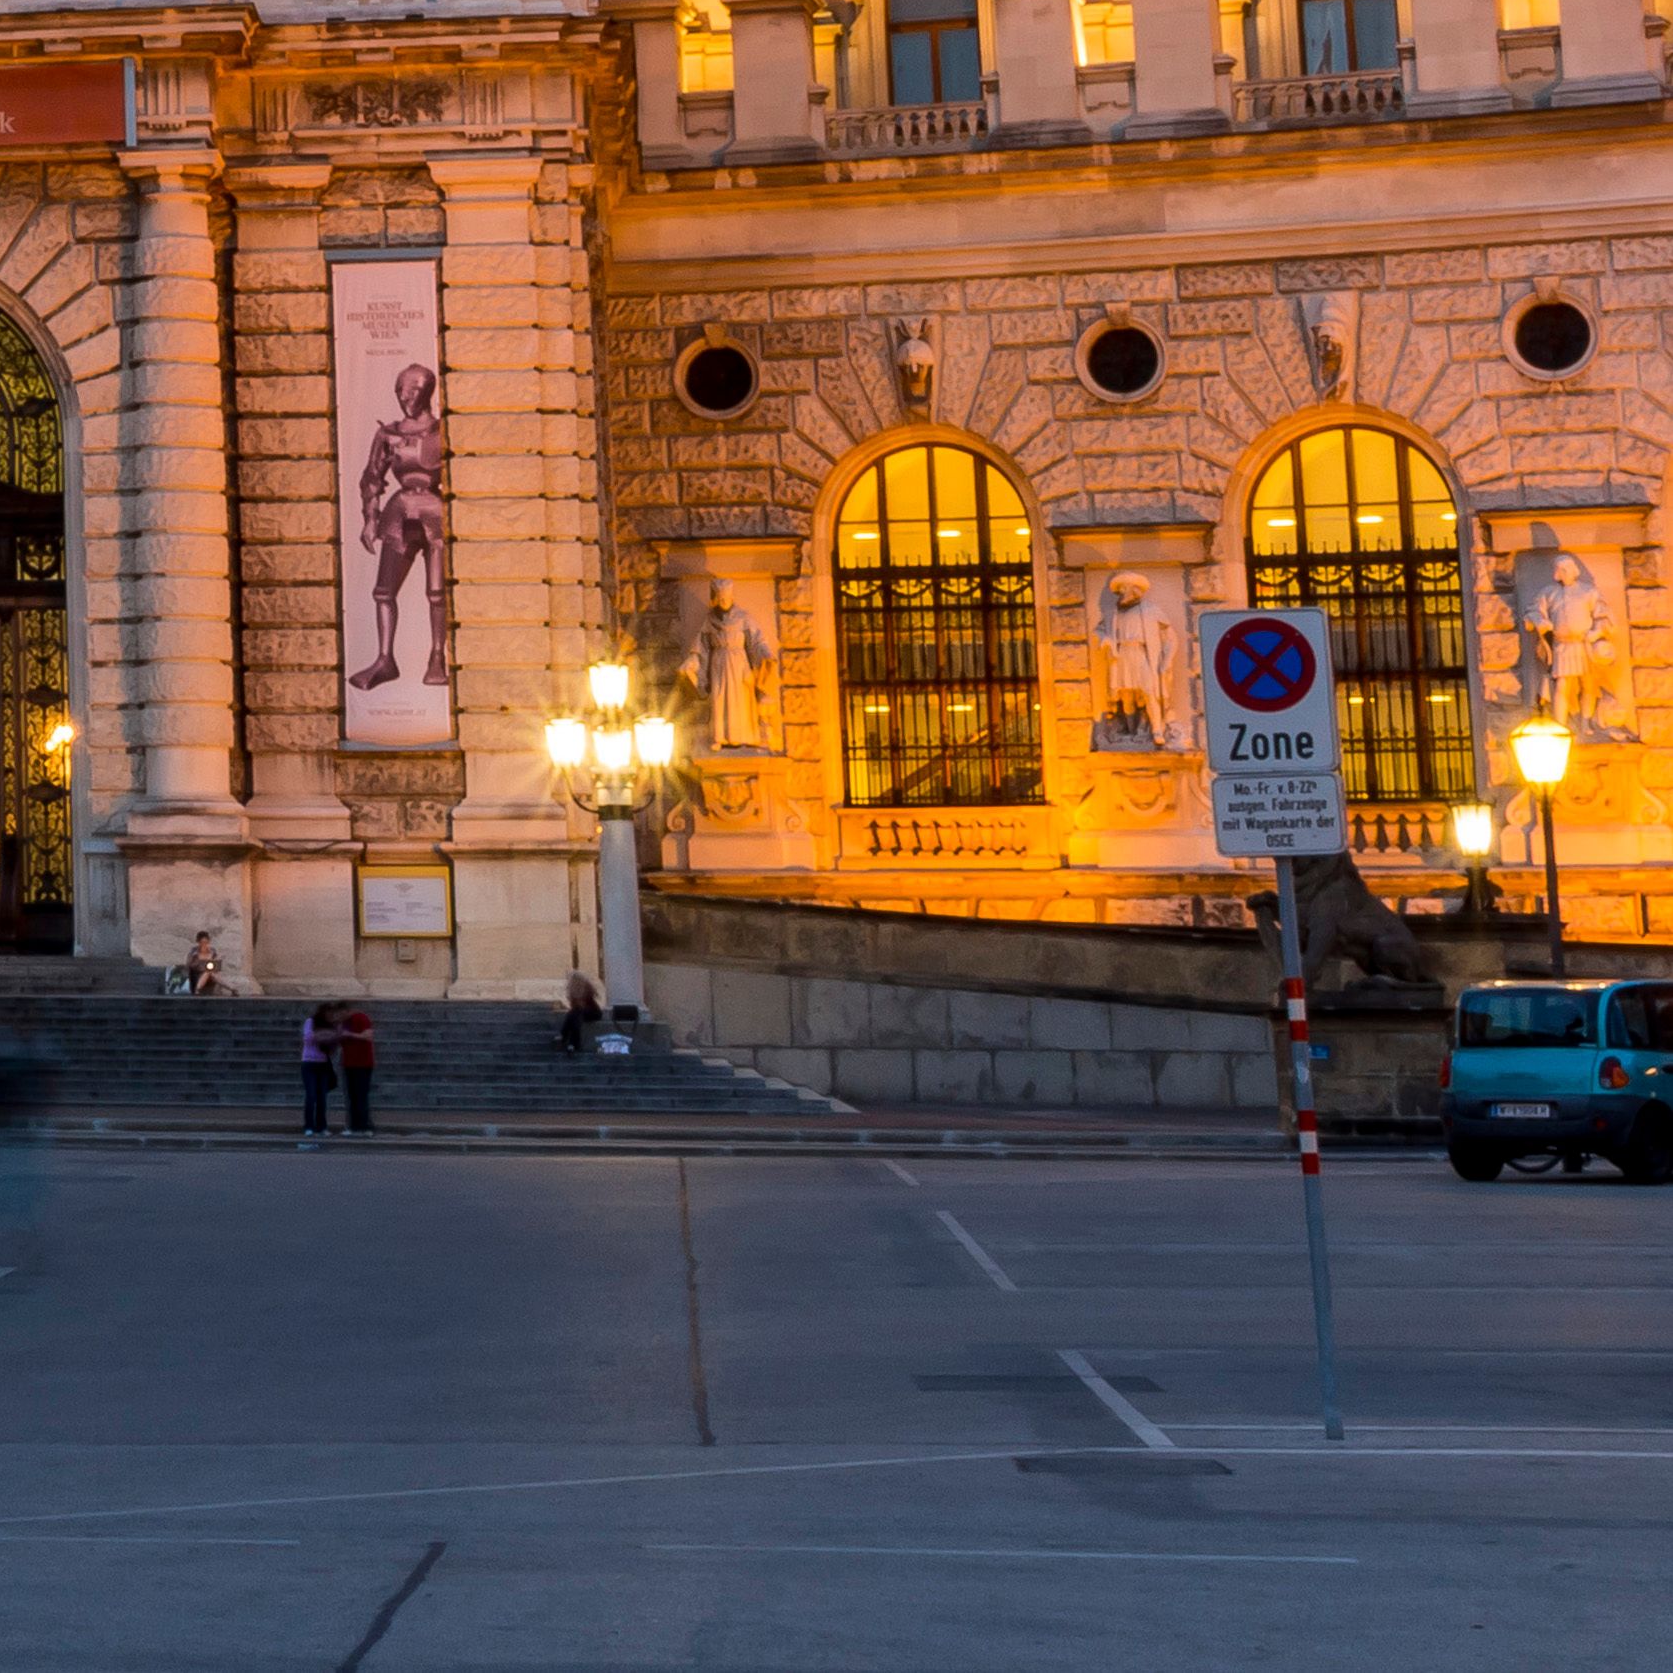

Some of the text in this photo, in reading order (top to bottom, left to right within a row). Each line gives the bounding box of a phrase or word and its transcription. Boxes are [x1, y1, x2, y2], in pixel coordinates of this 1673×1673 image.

[1228, 723, 1314, 761] Zone
[1271, 798, 1328, 813] Fahrzeuge
[1221, 815, 1335, 833] mit Wagenkarte der
